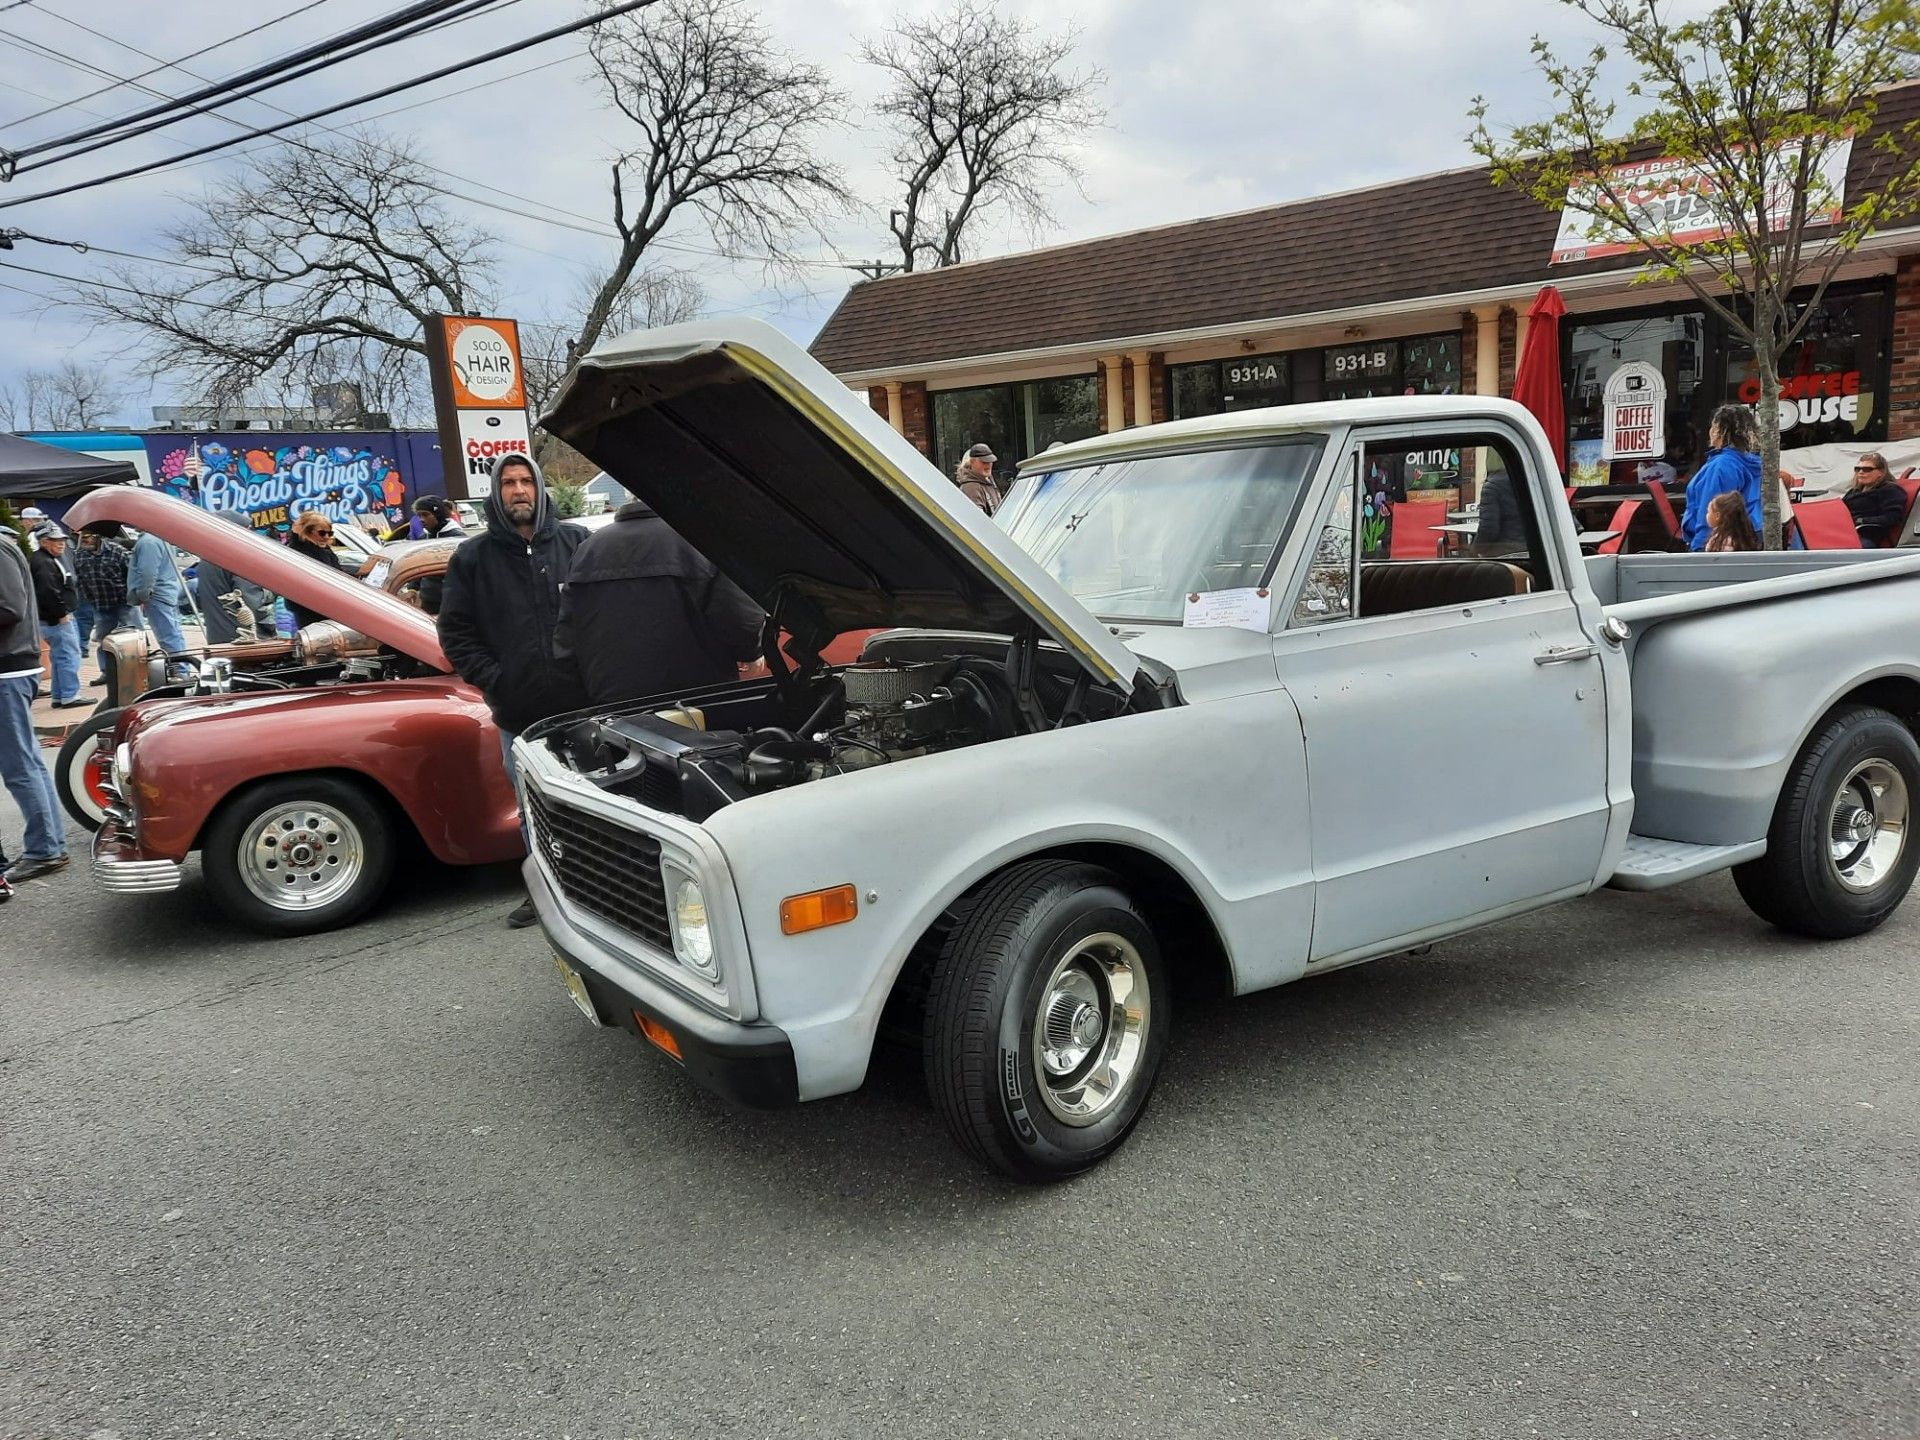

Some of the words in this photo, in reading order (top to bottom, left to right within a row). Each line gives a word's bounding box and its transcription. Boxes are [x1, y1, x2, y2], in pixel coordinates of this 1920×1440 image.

[472, 340, 502, 353] SOLO
[467, 354, 511, 374] HAIR
[1335, 352, 1387, 371] 931-B
[476, 376, 508, 385] DESIGN
[1230, 365, 1277, 383] 931-A
[1616, 406, 1653, 427] COFFEE
[1741, 395, 1859, 432] OUSE
[467, 440, 527, 457] COFFEE
[1615, 429, 1652, 451] HOUSE
[1405, 451, 1424, 465] on
[198, 464, 292, 514] Great
[291, 454, 369, 511] Things
[251, 506, 288, 528] TAKE
[549, 836, 562, 858] S
[1006, 1050, 1016, 1097] RADIAL
